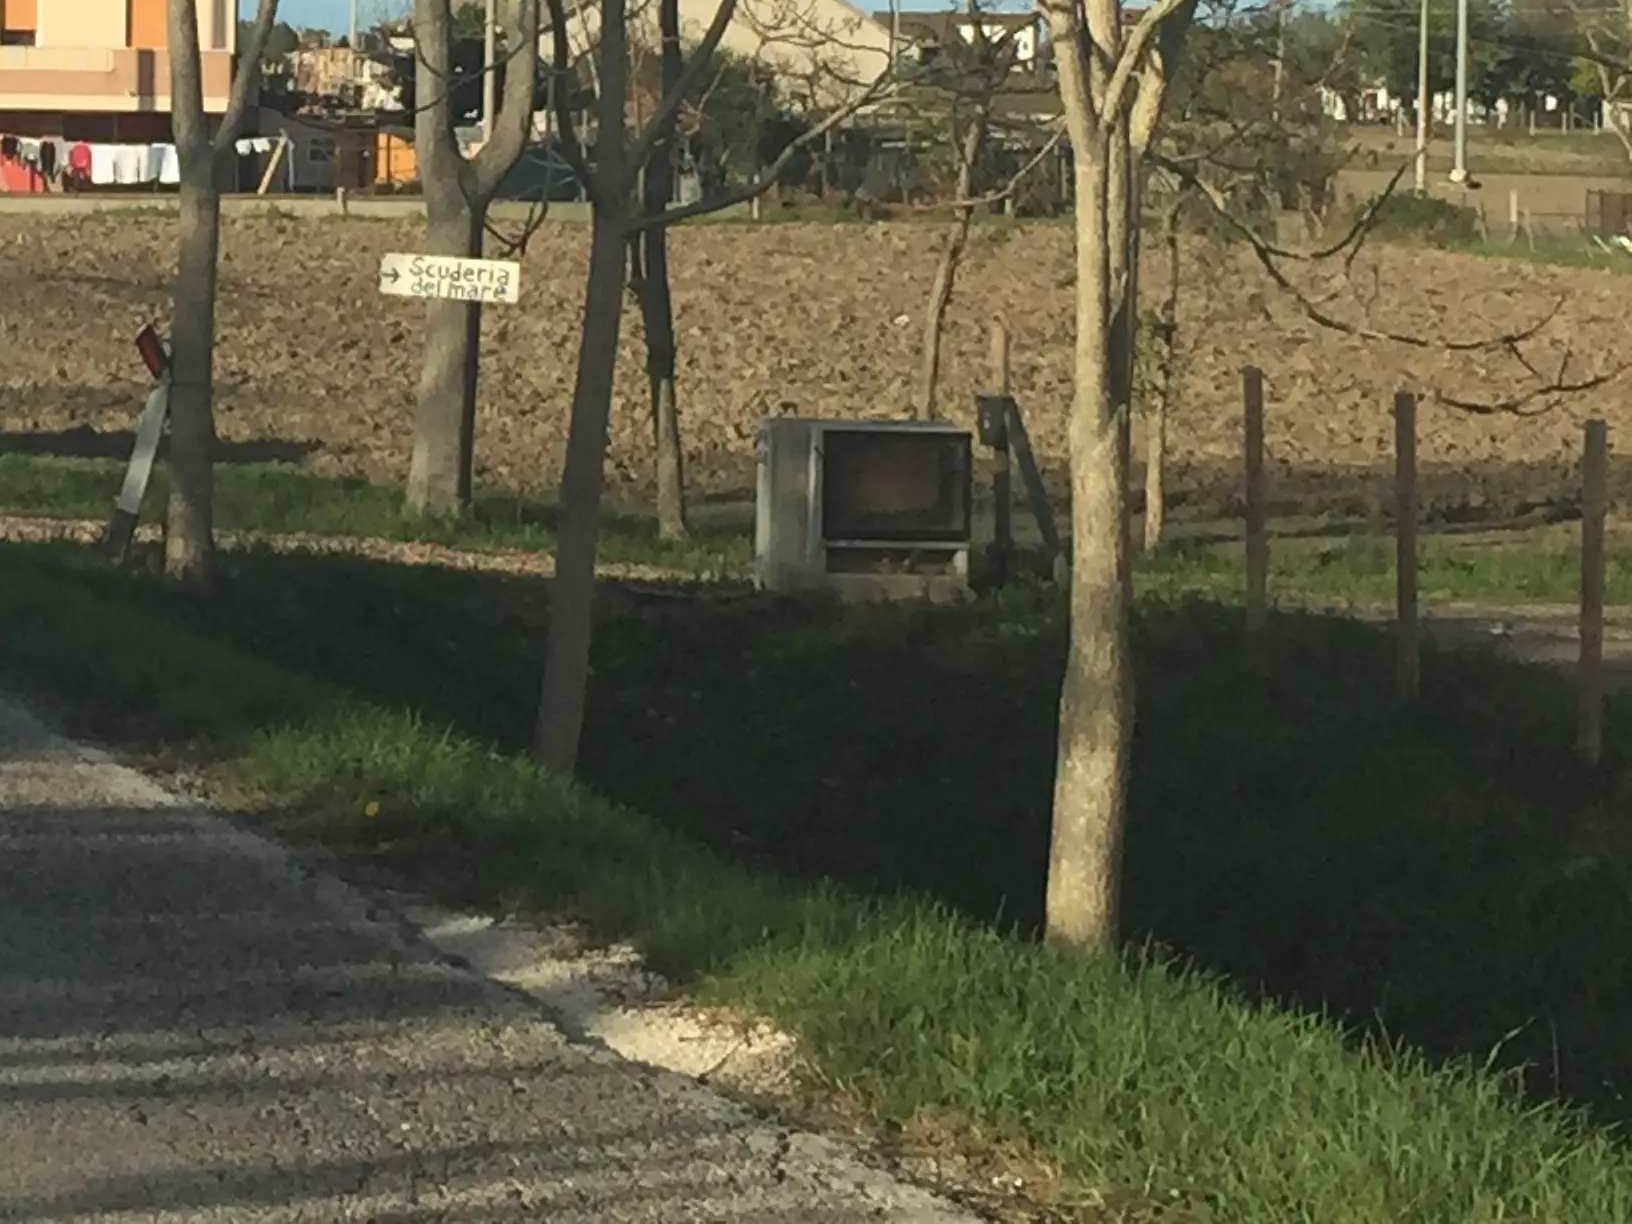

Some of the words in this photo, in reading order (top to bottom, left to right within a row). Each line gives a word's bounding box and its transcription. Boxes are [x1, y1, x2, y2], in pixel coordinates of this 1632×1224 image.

[409, 256, 510, 286] Scuderia
[411, 277, 441, 296] del
[447, 284, 508, 302] mare
